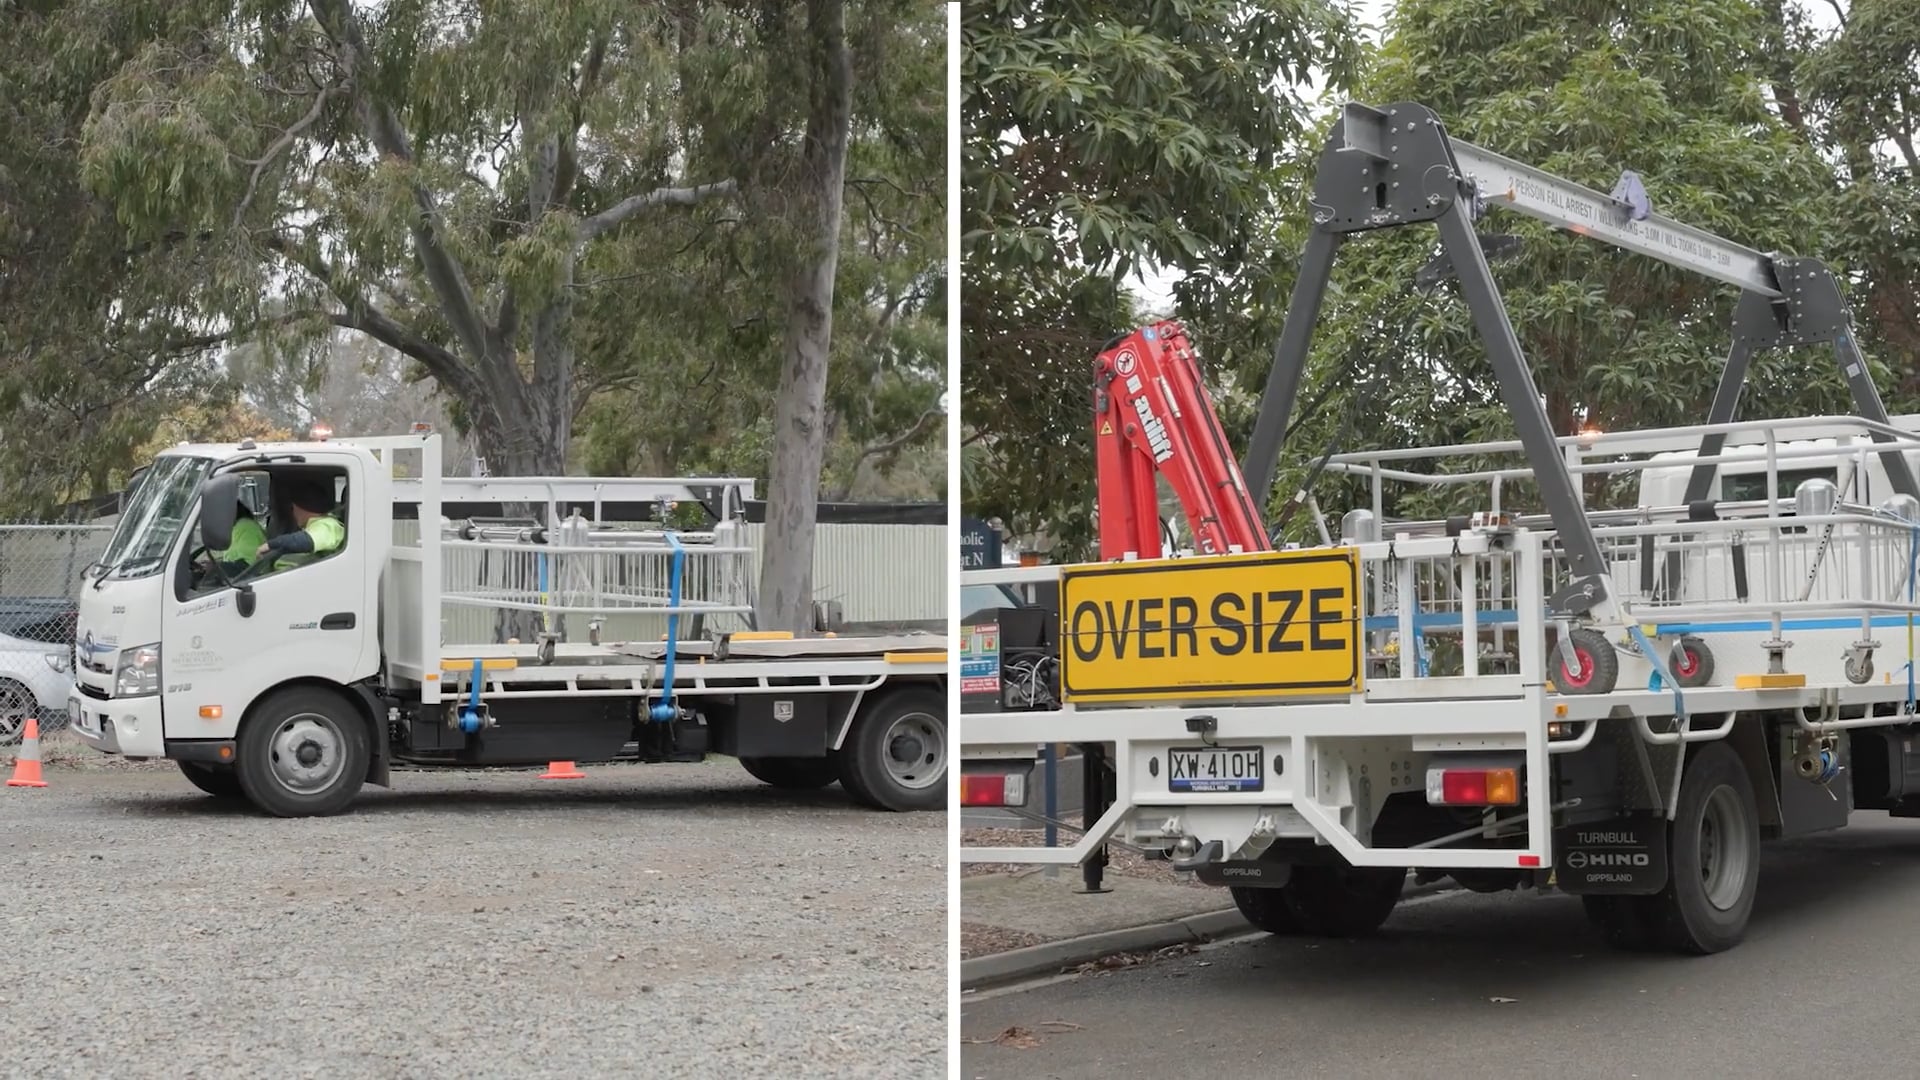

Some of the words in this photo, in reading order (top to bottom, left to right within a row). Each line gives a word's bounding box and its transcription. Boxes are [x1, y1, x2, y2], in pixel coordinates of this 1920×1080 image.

[1515, 179, 1546, 205] PERSON
[1547, 190, 1564, 209] FALL
[1565, 196, 1593, 220] ARREST
[1577, 832, 1637, 844] TURNBULL
[1590, 853, 1649, 866] HINO
[1223, 868, 1262, 876] GIPPSLAND
[1586, 873, 1633, 882] GIPPSLAND
